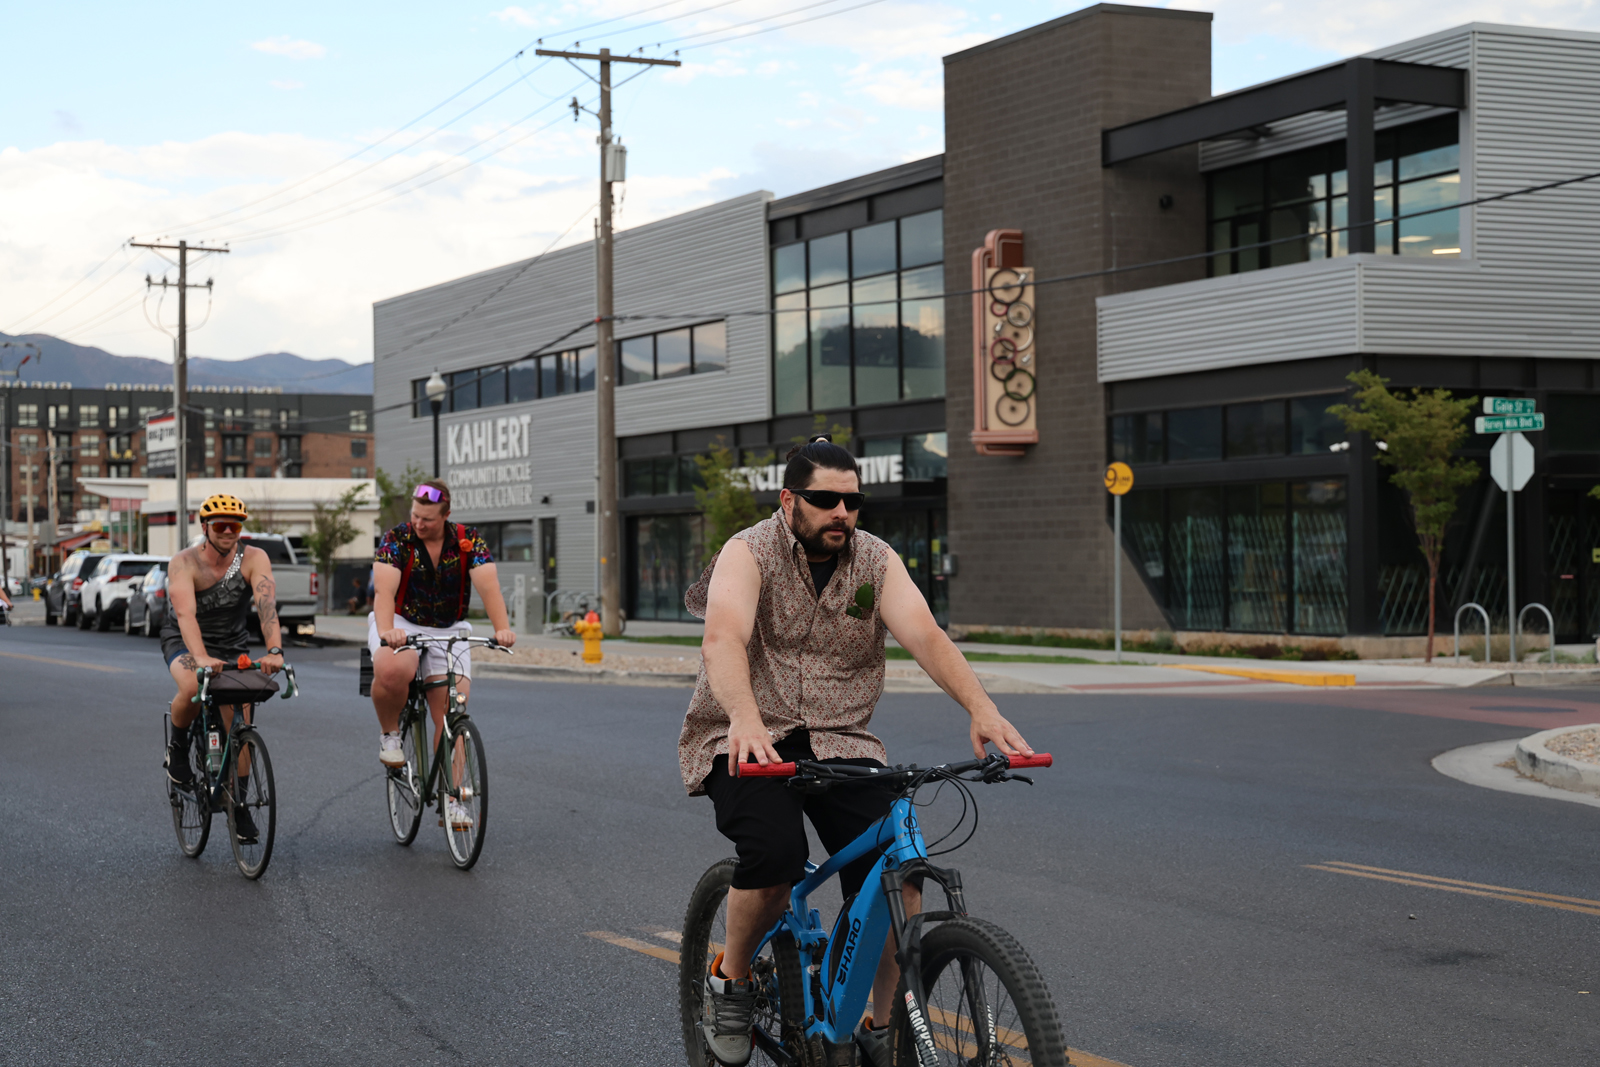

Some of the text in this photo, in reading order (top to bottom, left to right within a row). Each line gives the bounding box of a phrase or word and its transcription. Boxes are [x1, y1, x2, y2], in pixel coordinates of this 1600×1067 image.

[447, 414, 531, 465] KAHLERT
[448, 462, 532, 488] COMMUNITY BICYCLE
[855, 454, 903, 485] TIVE
[495, 484, 532, 508] CENTER
